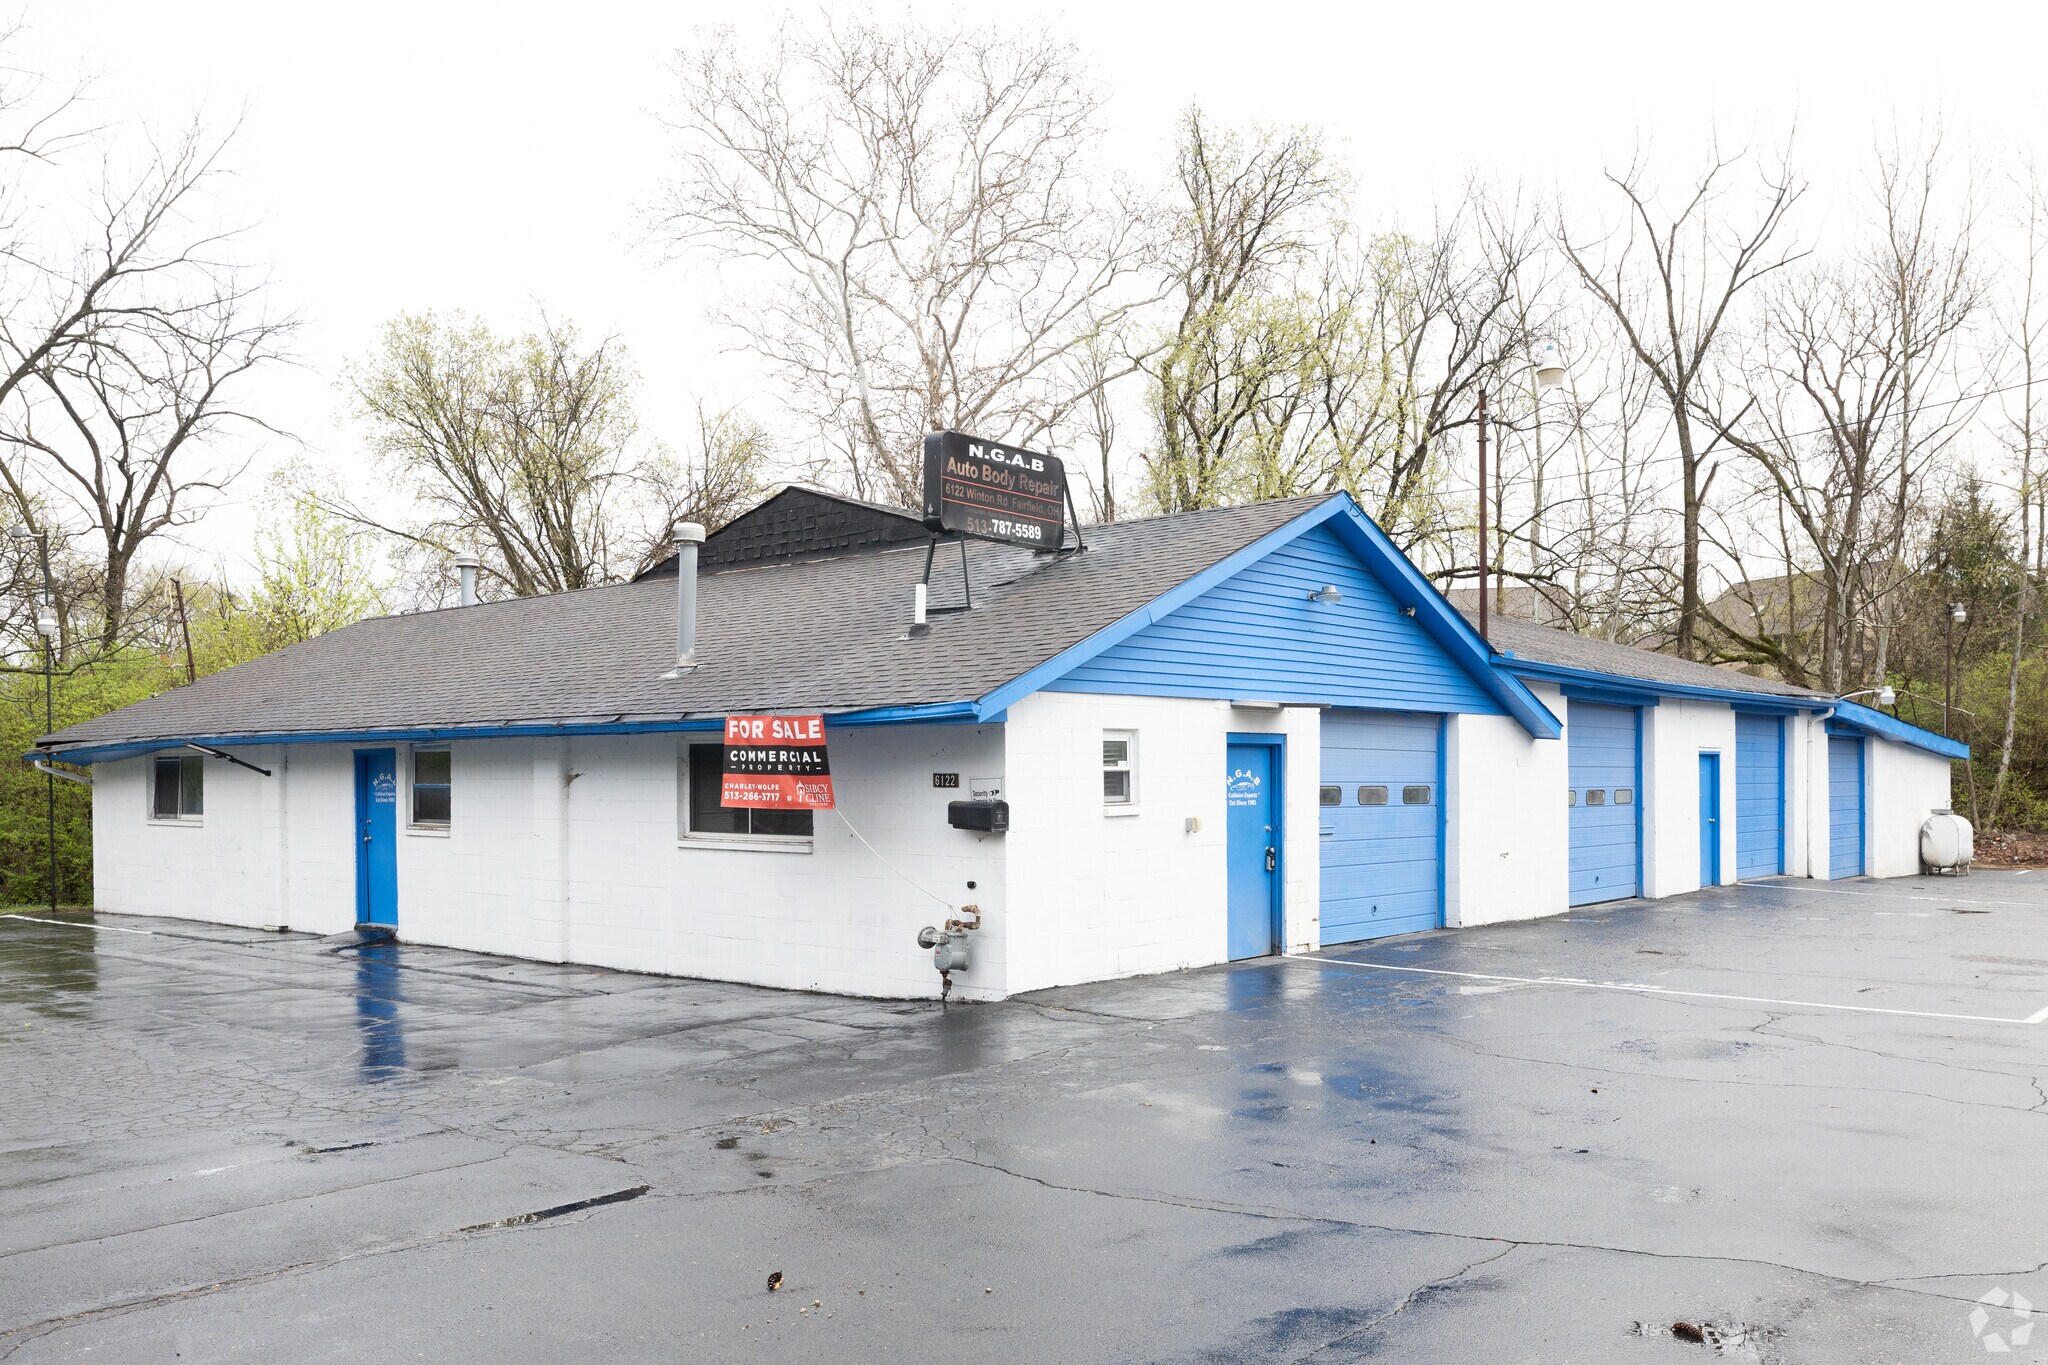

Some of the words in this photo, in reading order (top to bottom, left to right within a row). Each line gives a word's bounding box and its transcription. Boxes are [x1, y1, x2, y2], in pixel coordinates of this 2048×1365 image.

[969, 444, 1044, 472] N.G.A.B
[947, 457, 978, 478] Auto
[982, 465, 1015, 490] Body
[1019, 473, 1058, 496] Repair
[946, 483, 964, 497] 6122
[966, 487, 995, 503] Winton
[997, 495, 1008, 507] Rd
[1047, 505, 1059, 516] OH
[967, 516, 1041, 540] 513-787-5589
[729, 720, 764, 738] FOR
[772, 720, 821, 739] SALE
[730, 750, 821, 762] COMMERCIAL
[935, 775, 955, 786] 6122
[1227, 769, 1260, 786] N.G.A.B
[805, 784, 828, 792] SIBCY
[973, 790, 988, 798] Security
[724, 792, 780, 801] 513-266-3717
[806, 794, 830, 802] CLINE
